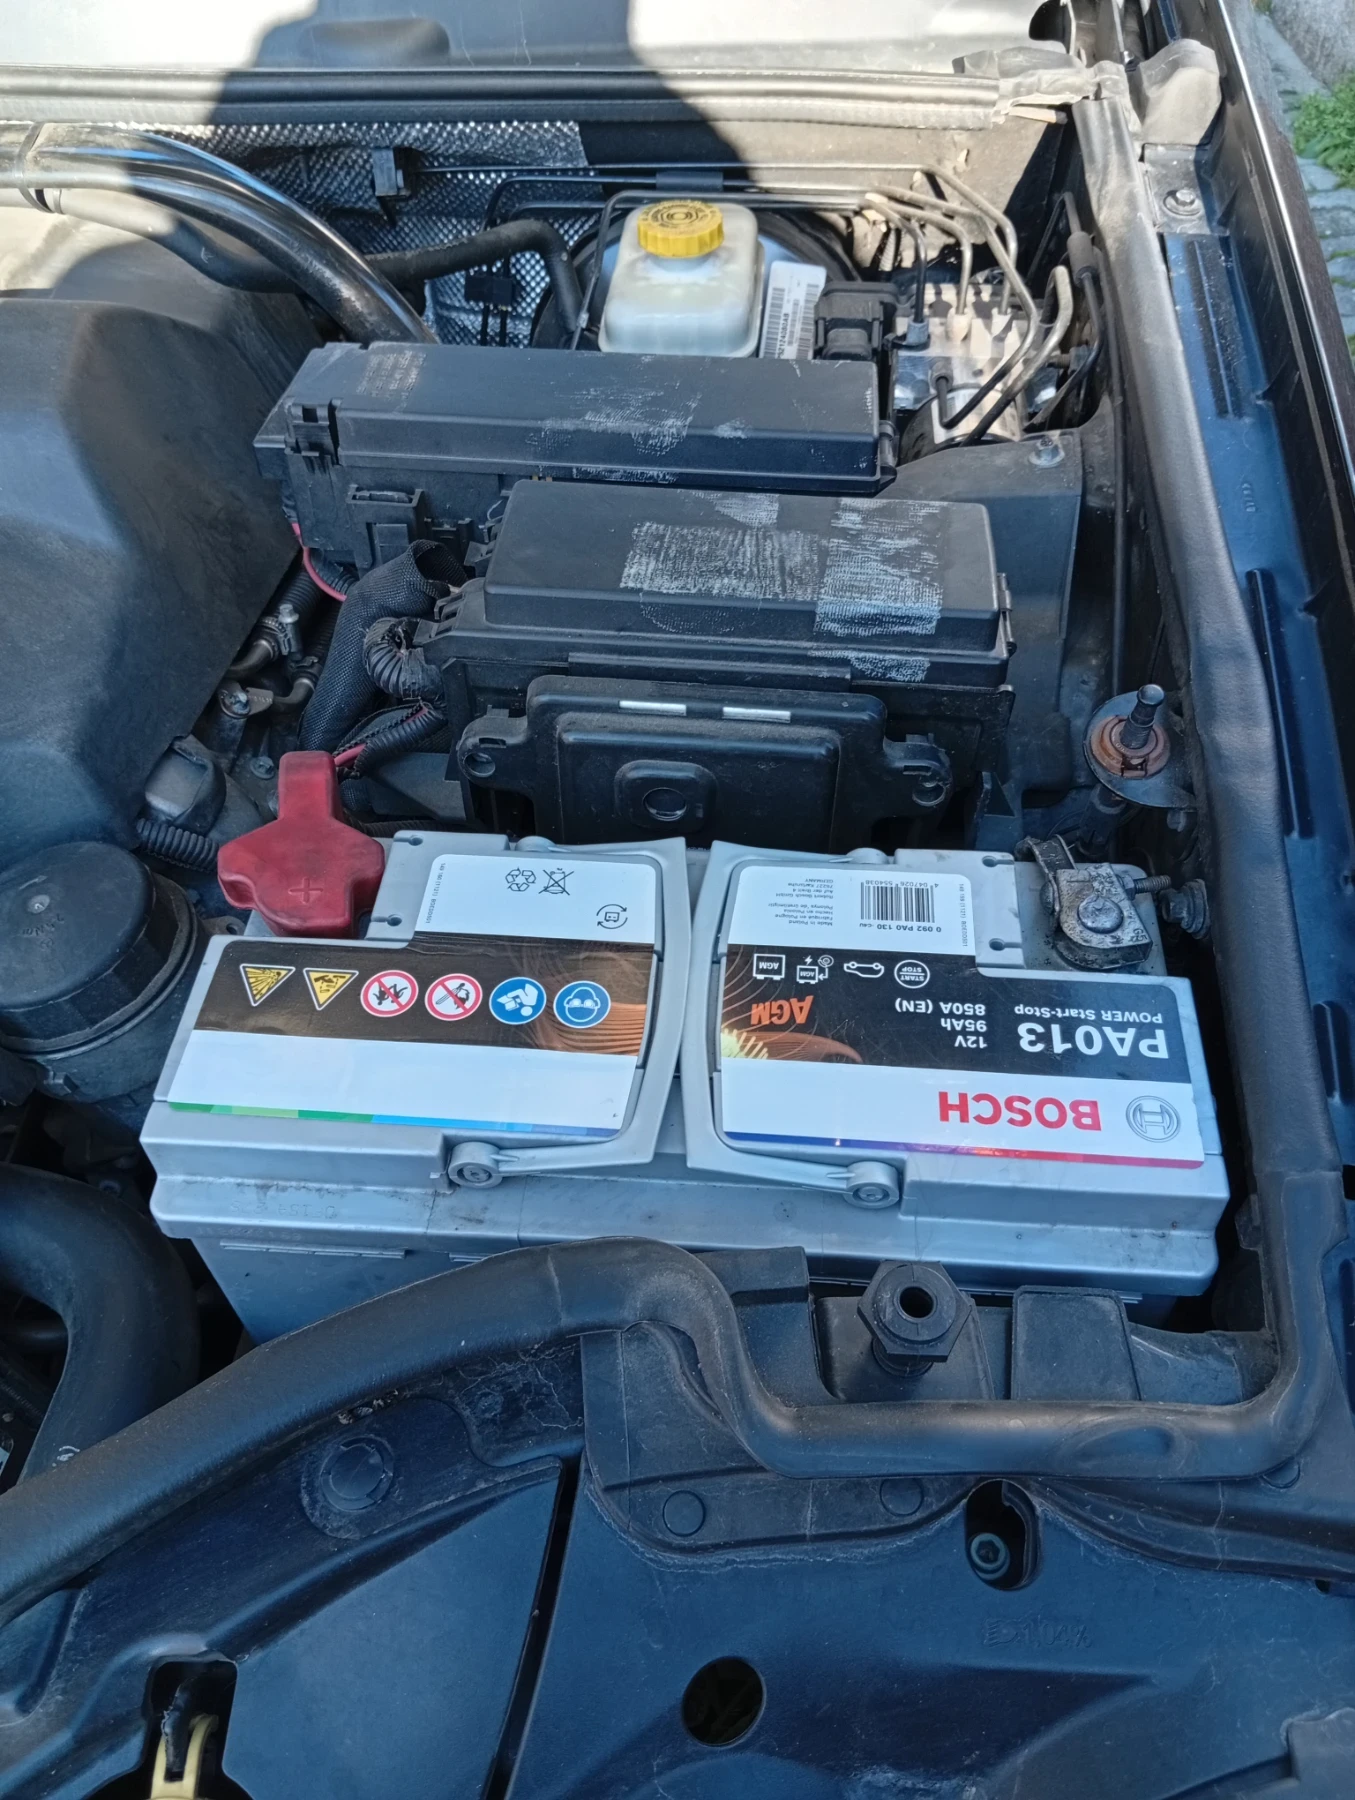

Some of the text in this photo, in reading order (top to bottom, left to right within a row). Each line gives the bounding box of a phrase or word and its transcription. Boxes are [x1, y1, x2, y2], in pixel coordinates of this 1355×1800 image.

[759, 962, 779, 970] AGM
[750, 995, 814, 1024] AGM
[895, 998, 986, 1015] 850A (EN)
[1014, 1004, 1162, 1024] POWER Start-Stop
[940, 1017, 987, 1032] 95Ah
[954, 1035, 988, 1049] 12V
[1017, 1022, 1169, 1060] PA013
[938, 1091, 1101, 1131] BOSCH
